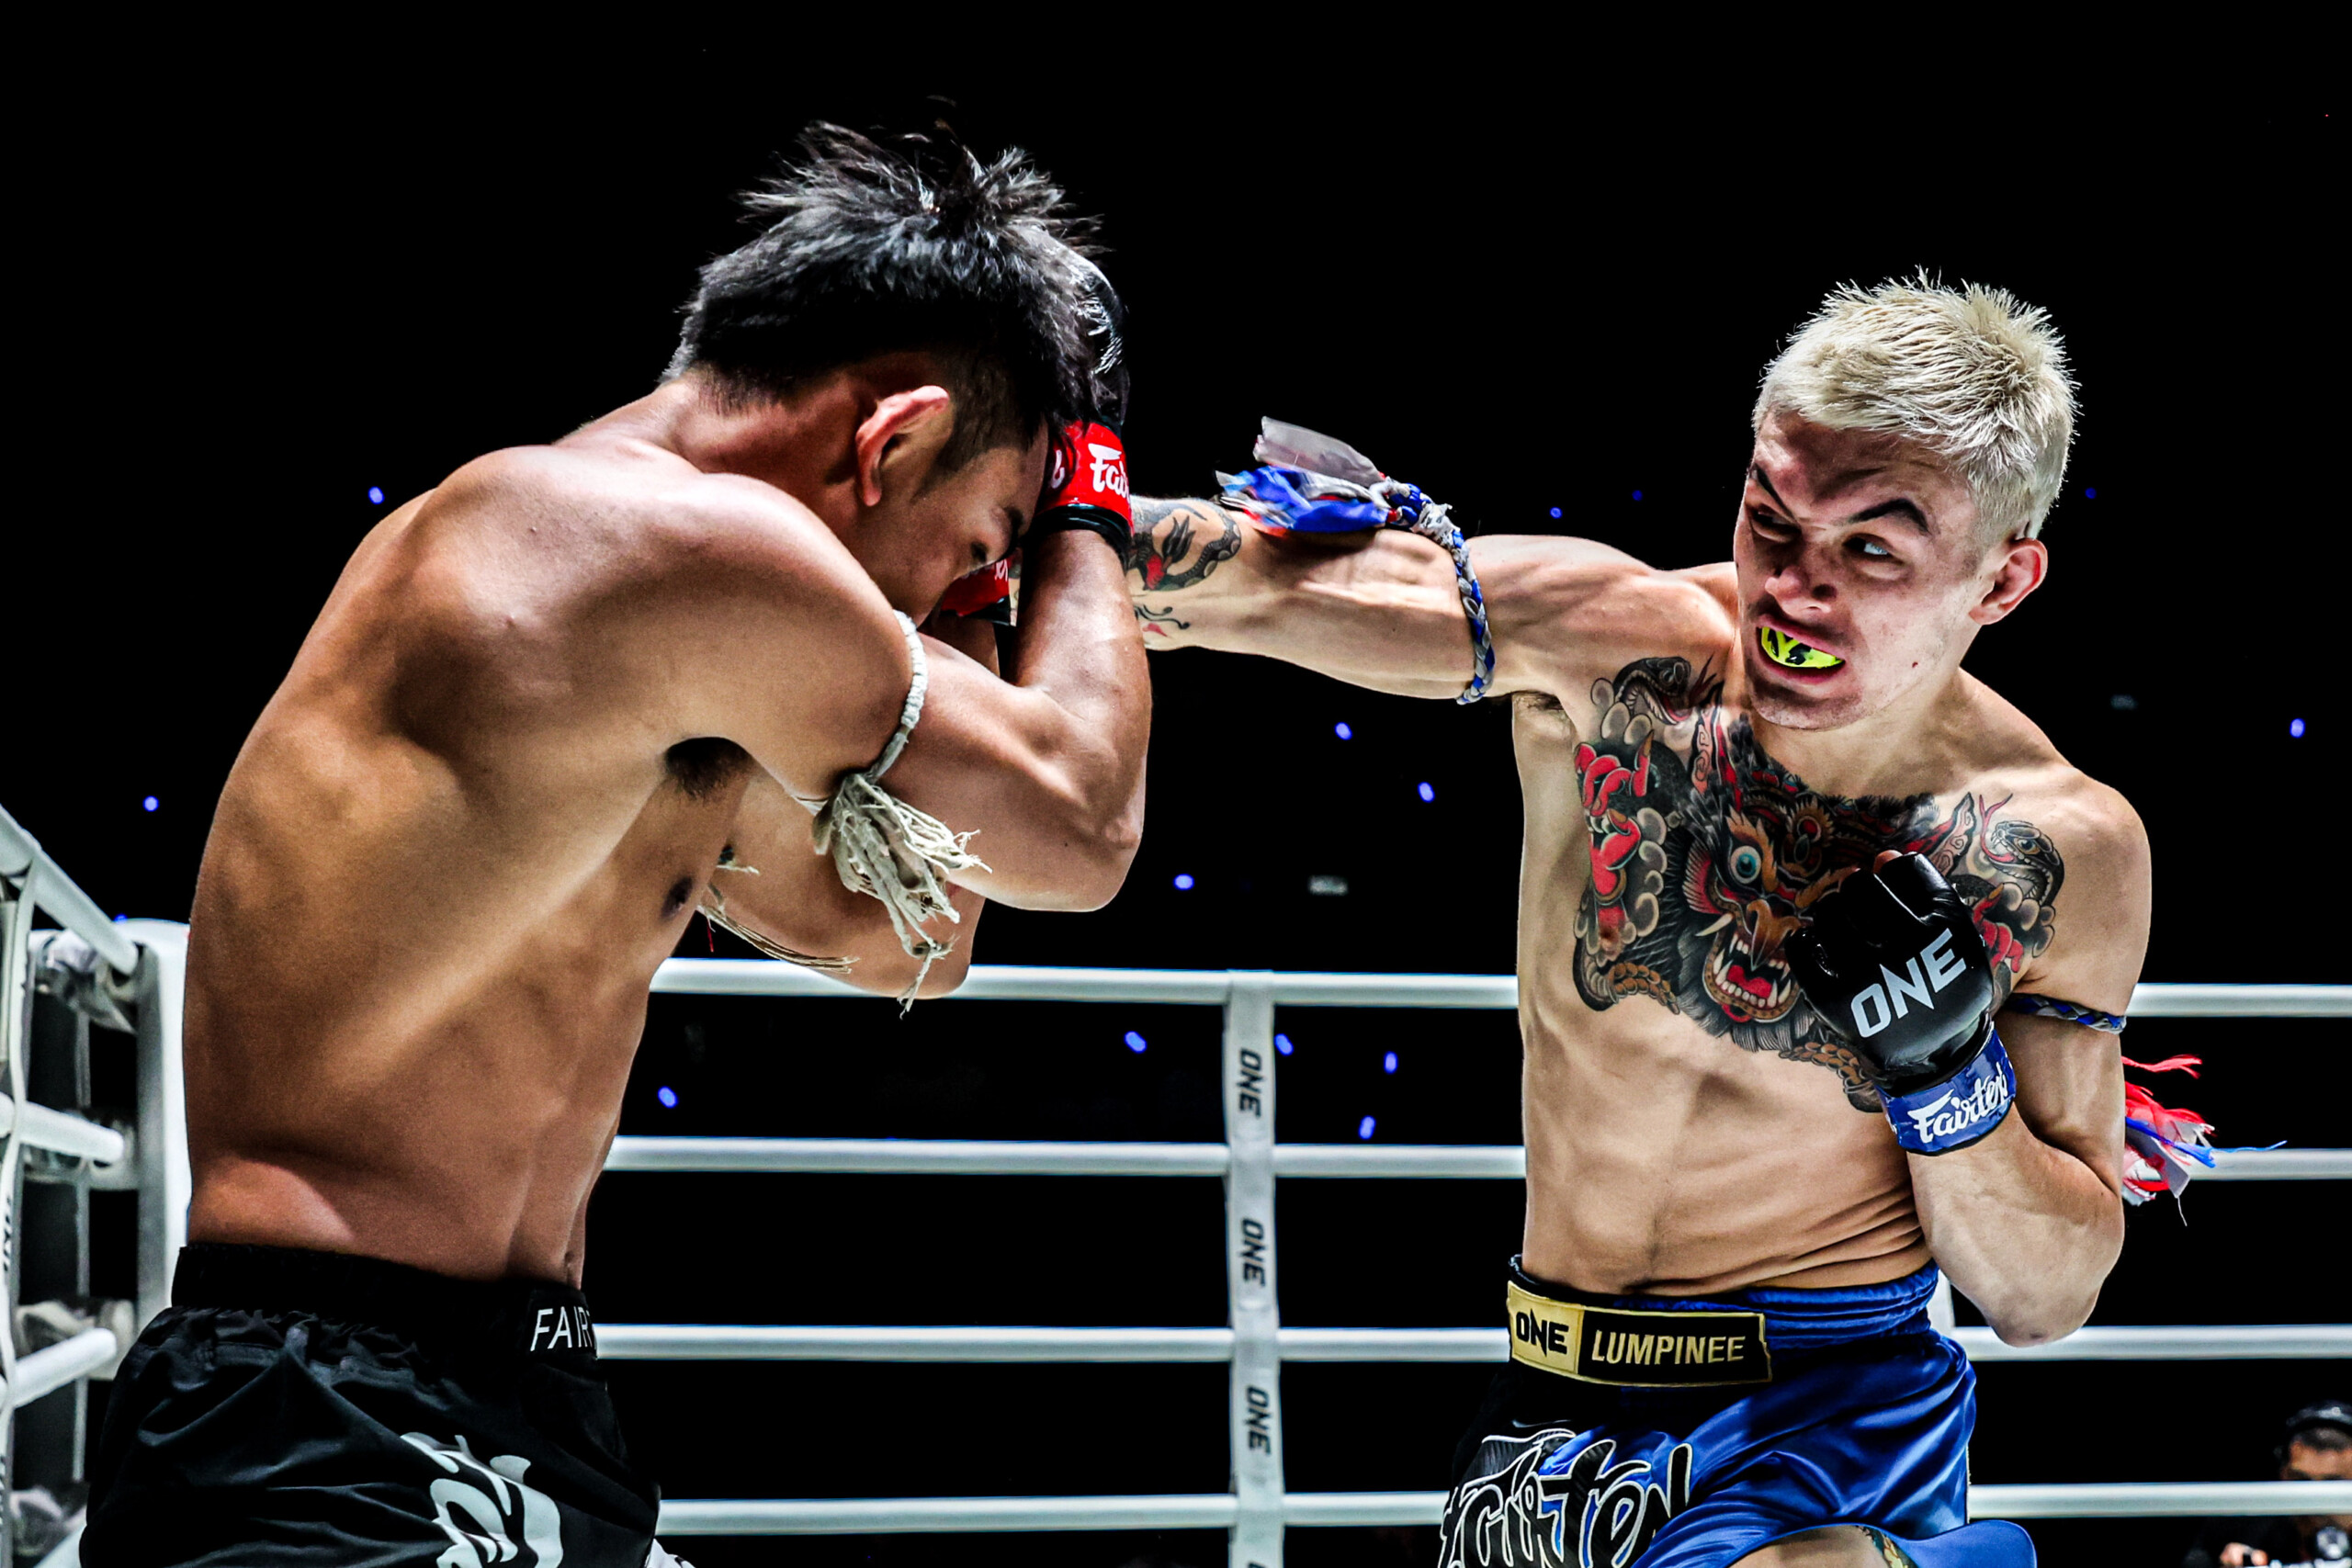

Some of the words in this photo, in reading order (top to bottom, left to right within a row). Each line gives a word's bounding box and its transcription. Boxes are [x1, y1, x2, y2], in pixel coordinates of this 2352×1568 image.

[1850, 928, 1967, 1038] ONE
[1238, 1048, 1262, 1118] ONE
[1907, 1061, 2008, 1144] Fairtex
[1239, 1218, 1265, 1287] ONE
[530, 1305, 593, 1352] FAIR
[1515, 1308, 1570, 1358] ONE
[1591, 1329, 1746, 1366] LUMPINEE
[1245, 1385, 1272, 1455] ONE
